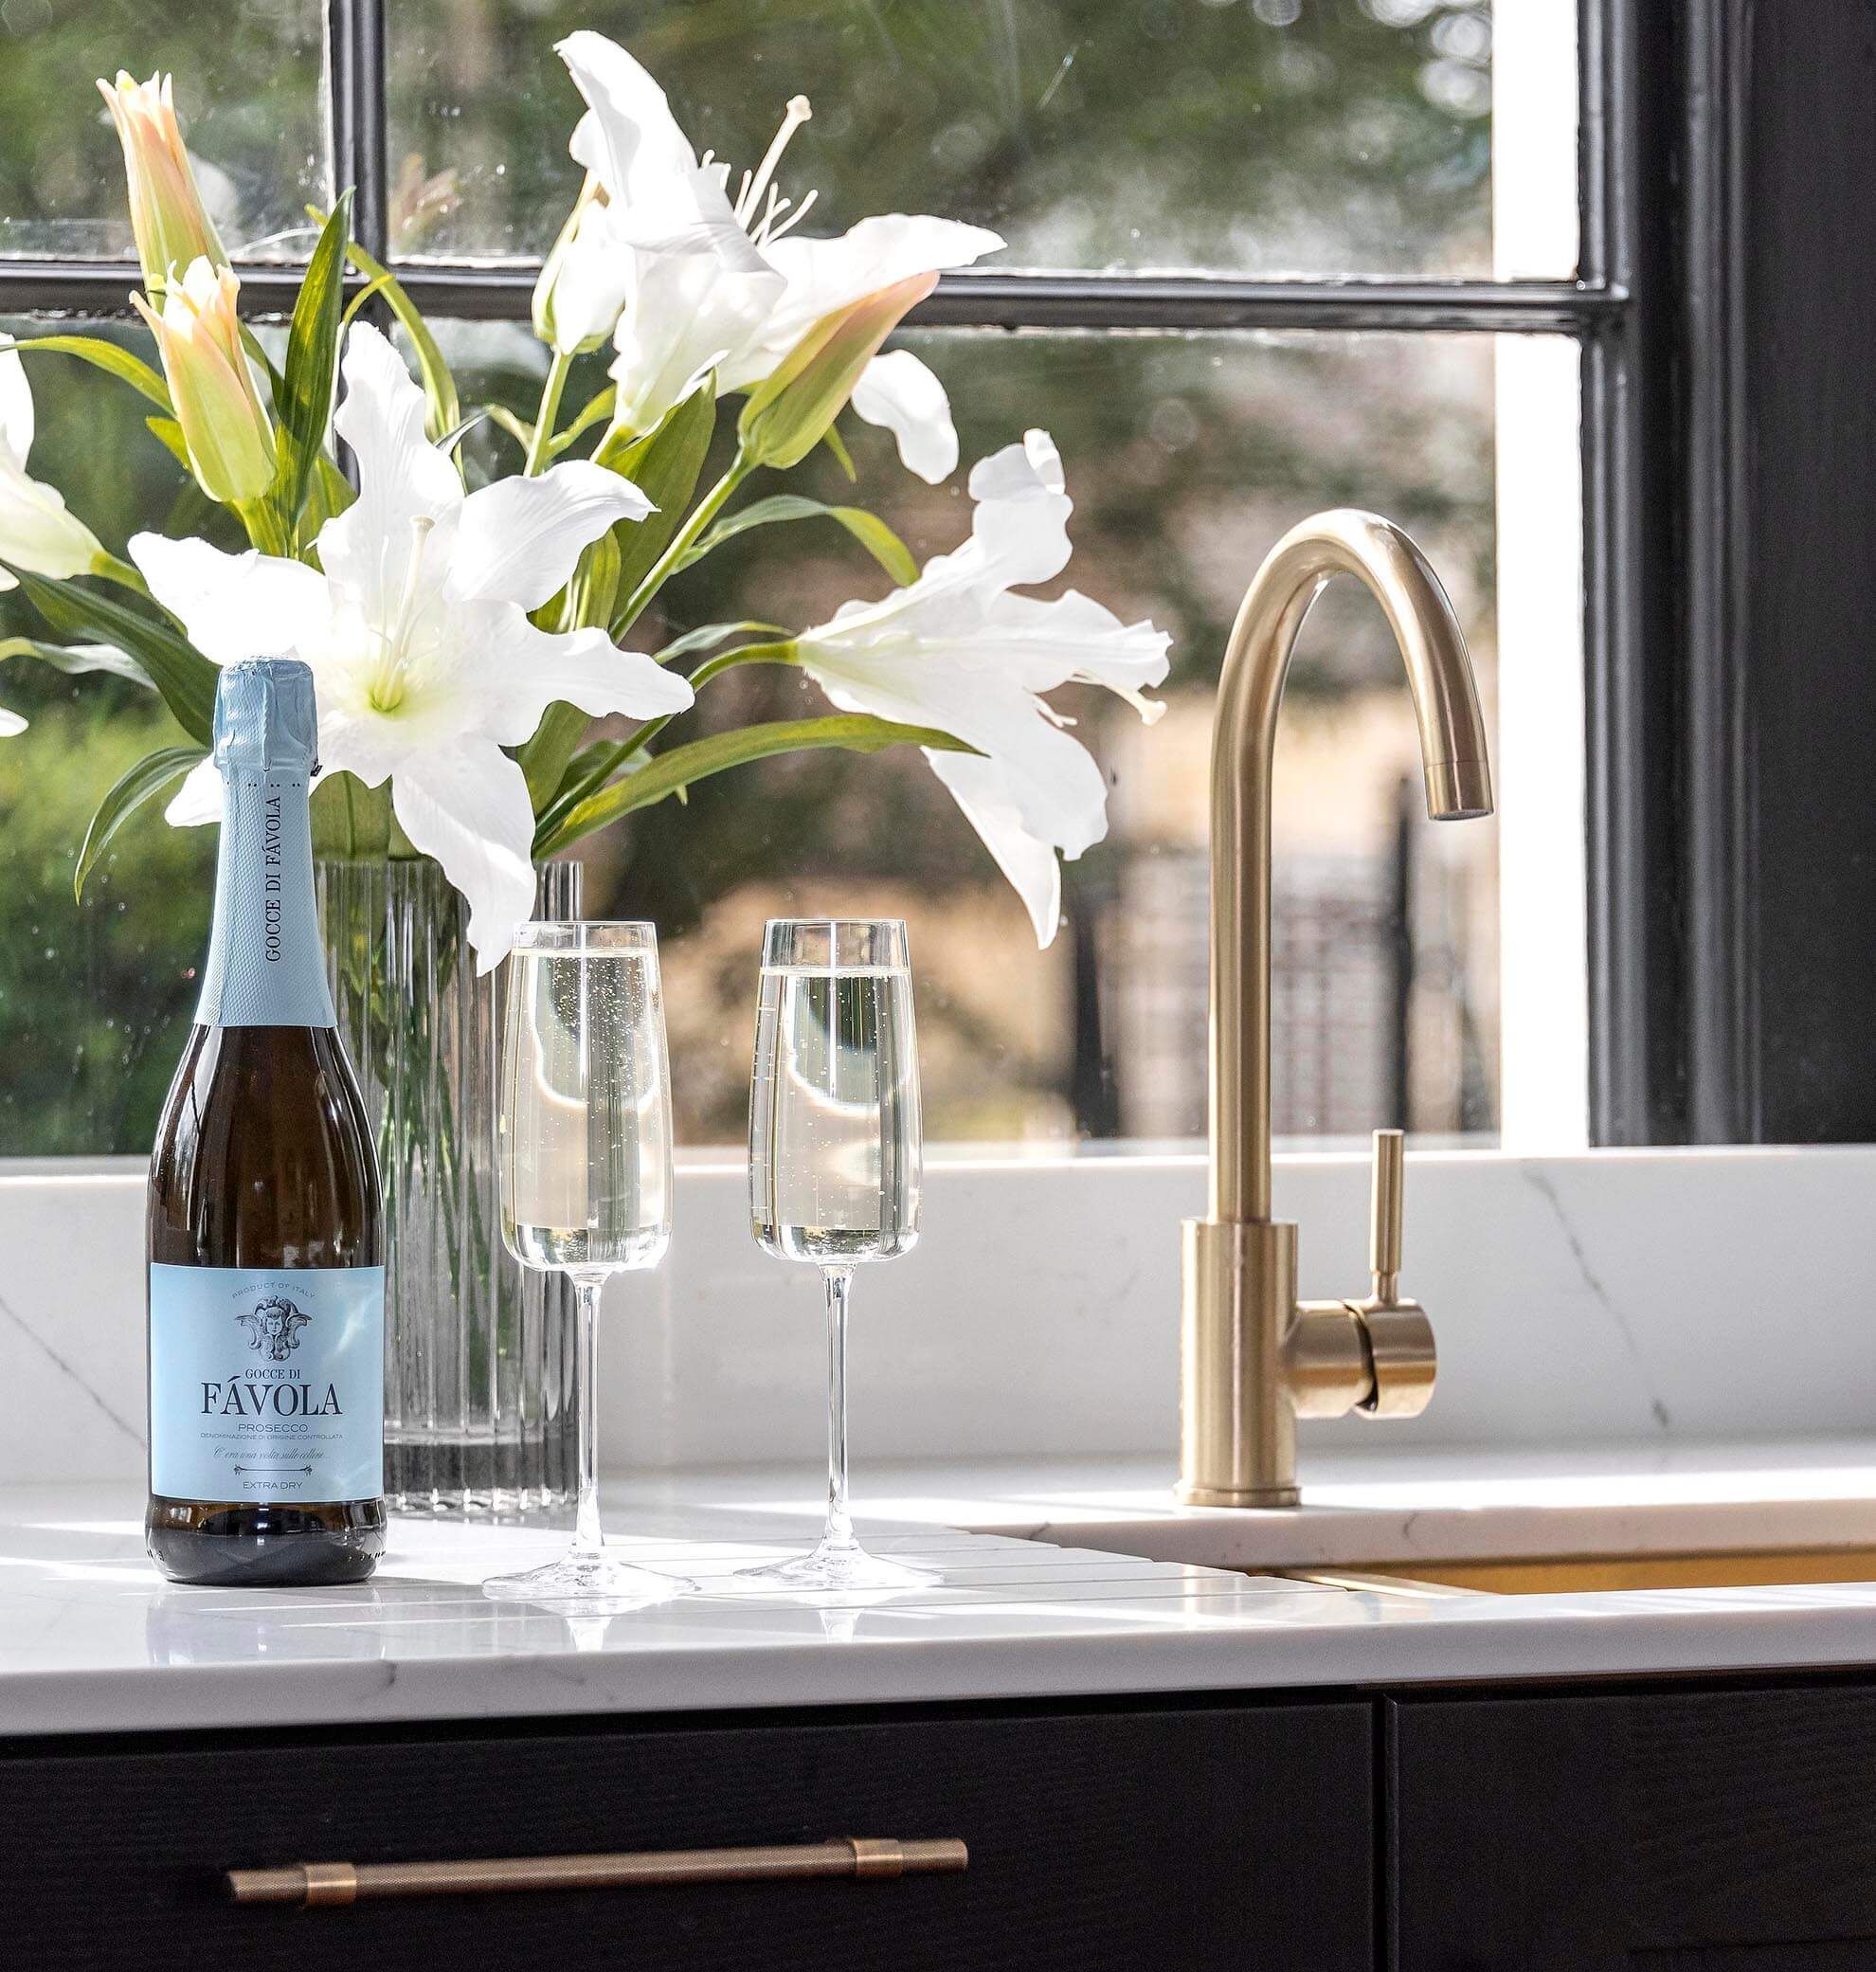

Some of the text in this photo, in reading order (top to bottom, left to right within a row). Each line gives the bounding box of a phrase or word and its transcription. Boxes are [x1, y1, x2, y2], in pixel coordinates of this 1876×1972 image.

[262, 795, 281, 963] GOCCE DI FÁVOLA
[232, 1282, 275, 1298] PRODUCT
[293, 1285, 316, 1298] ITALY
[244, 1368, 300, 1380] GOCCE DI
[201, 1376, 343, 1416] FÁVOLA
[238, 1423, 309, 1433] PROSECCO
